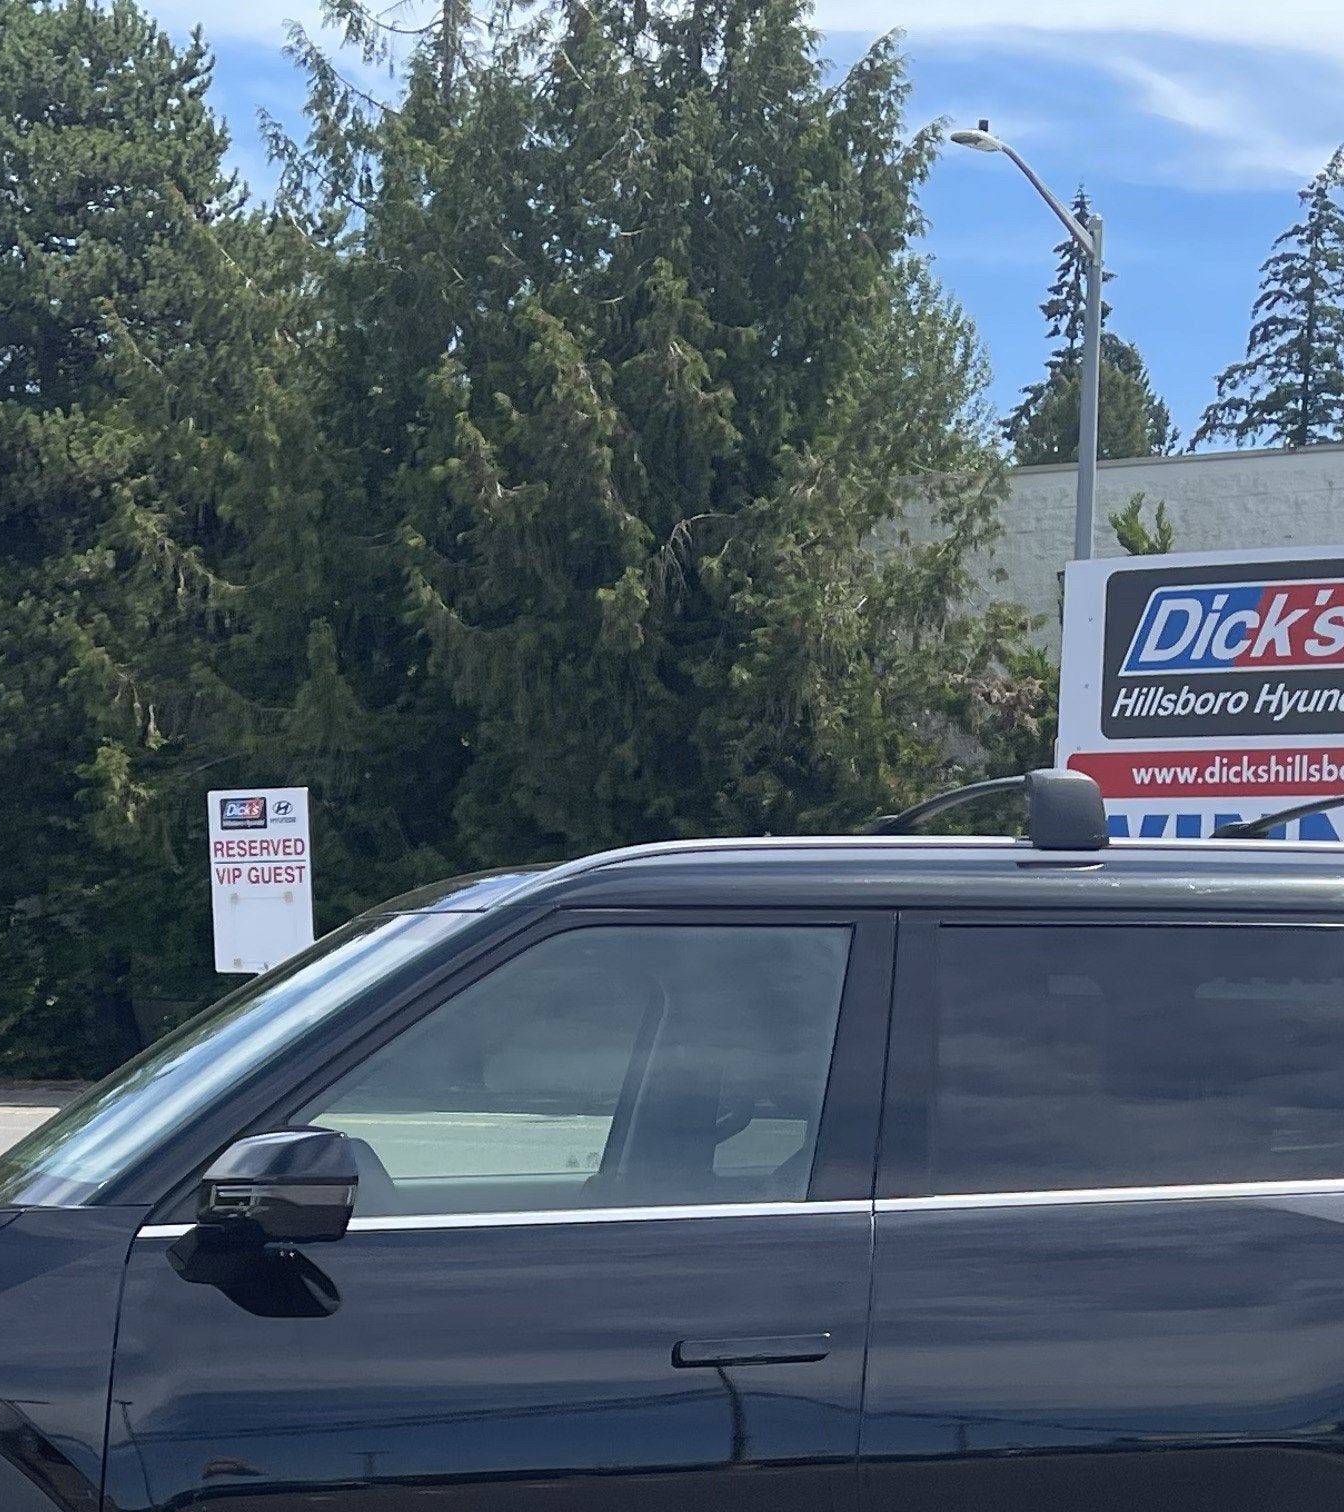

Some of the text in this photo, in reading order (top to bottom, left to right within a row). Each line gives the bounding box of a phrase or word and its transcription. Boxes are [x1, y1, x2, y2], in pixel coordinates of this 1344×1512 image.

[1111, 686, 1248, 717] Hillsboro
[213, 838, 305, 858] RESERVED
[216, 866, 306, 885] VIP GUEST
